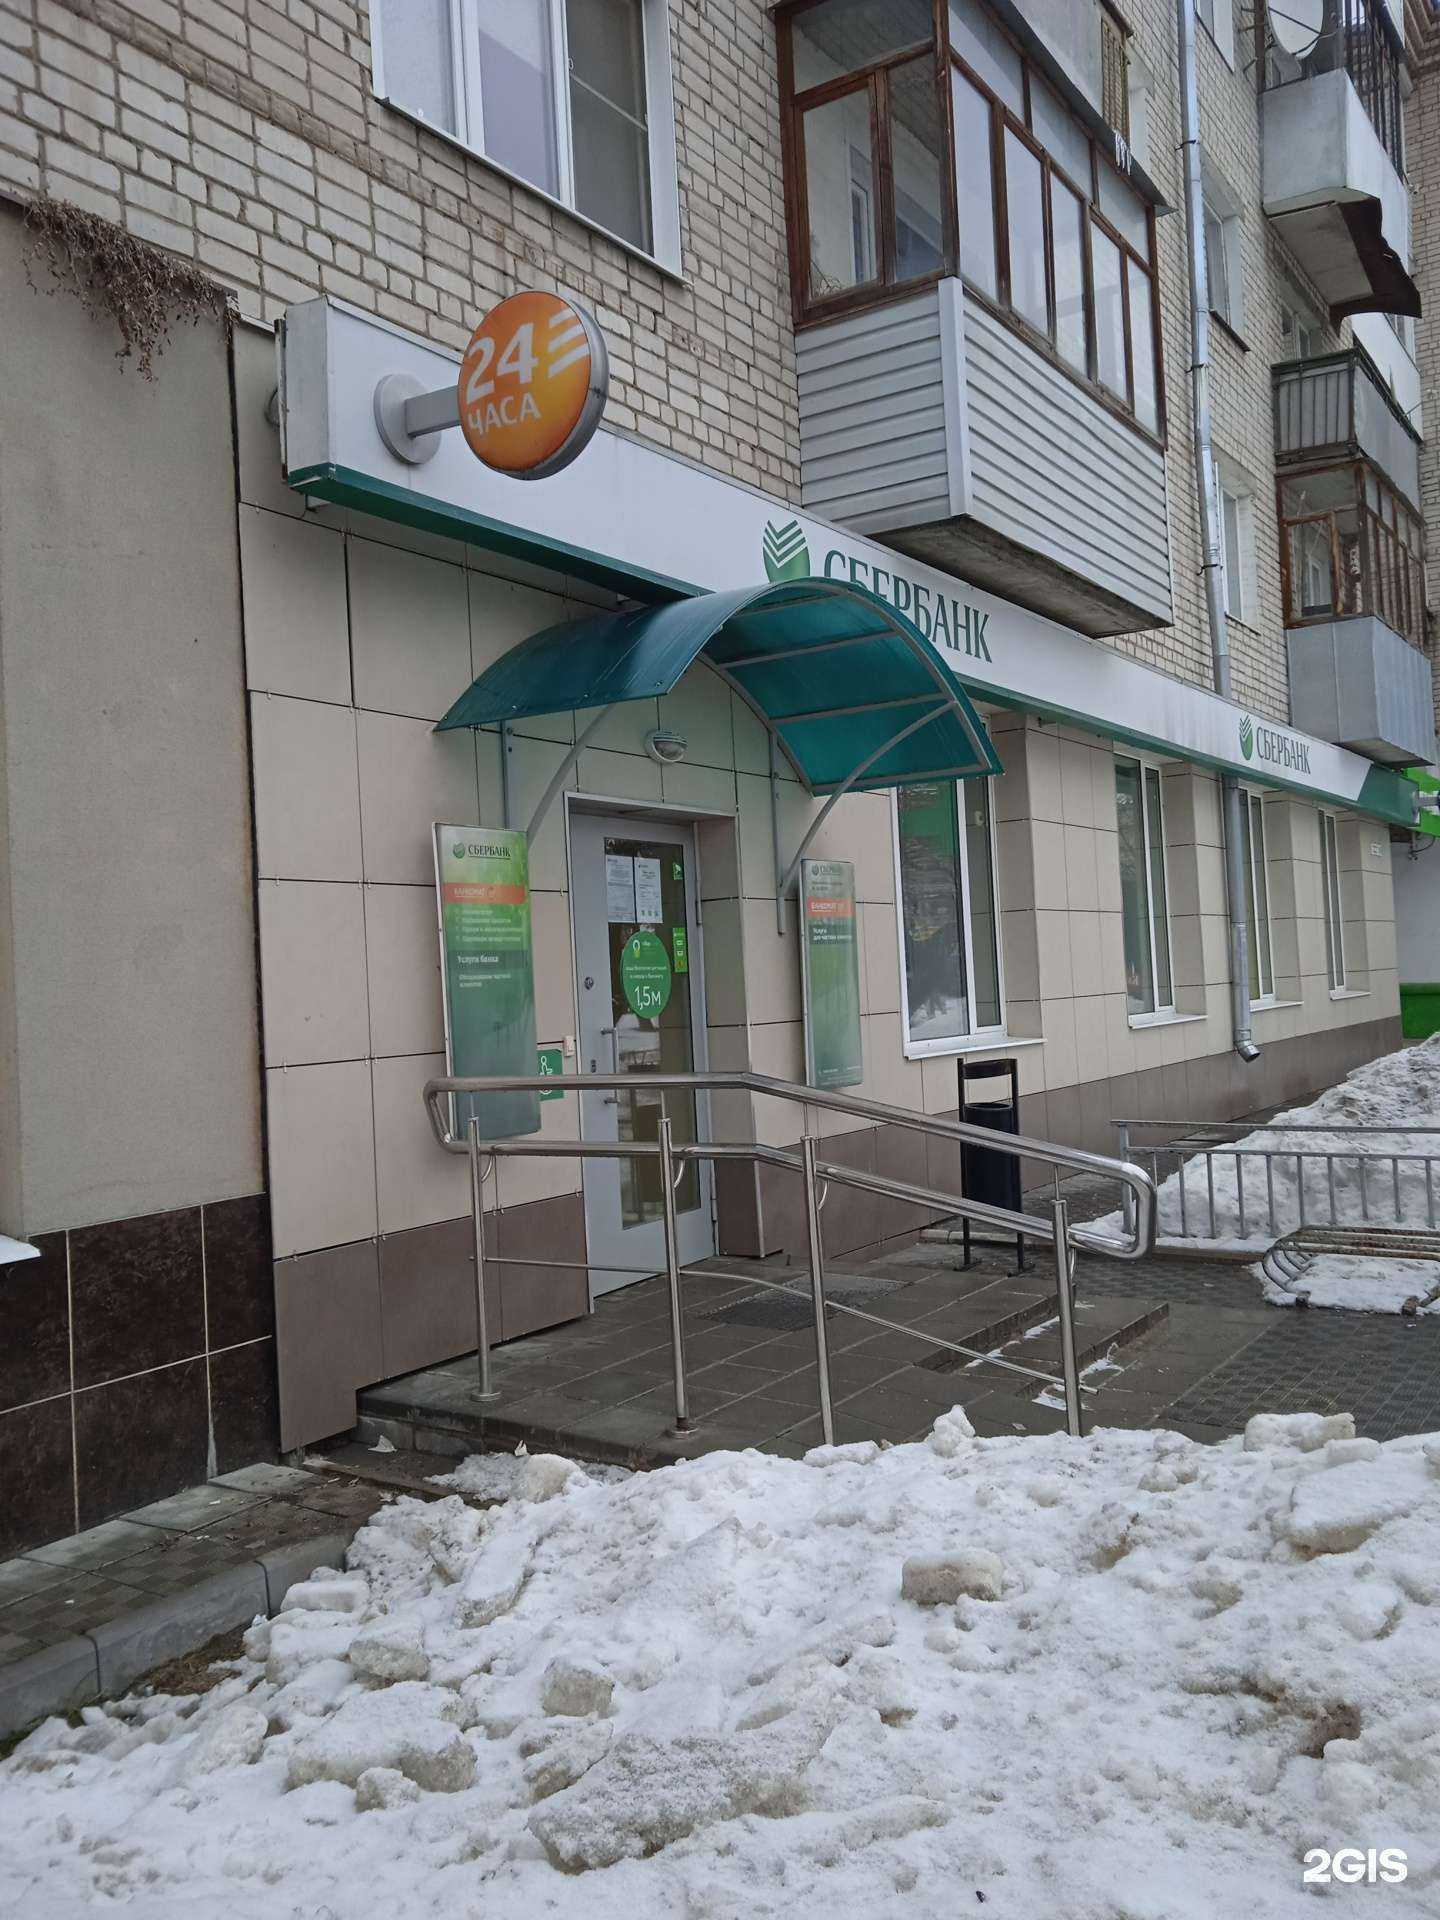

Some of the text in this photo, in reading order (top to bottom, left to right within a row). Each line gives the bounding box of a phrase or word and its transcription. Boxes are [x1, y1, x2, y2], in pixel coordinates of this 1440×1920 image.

[466, 322, 539, 405] 24
[467, 391, 542, 436] ЧАСА
[1256, 726, 1311, 775] СБЕРБАНК
[468, 844, 511, 857] СБЕРБАНК
